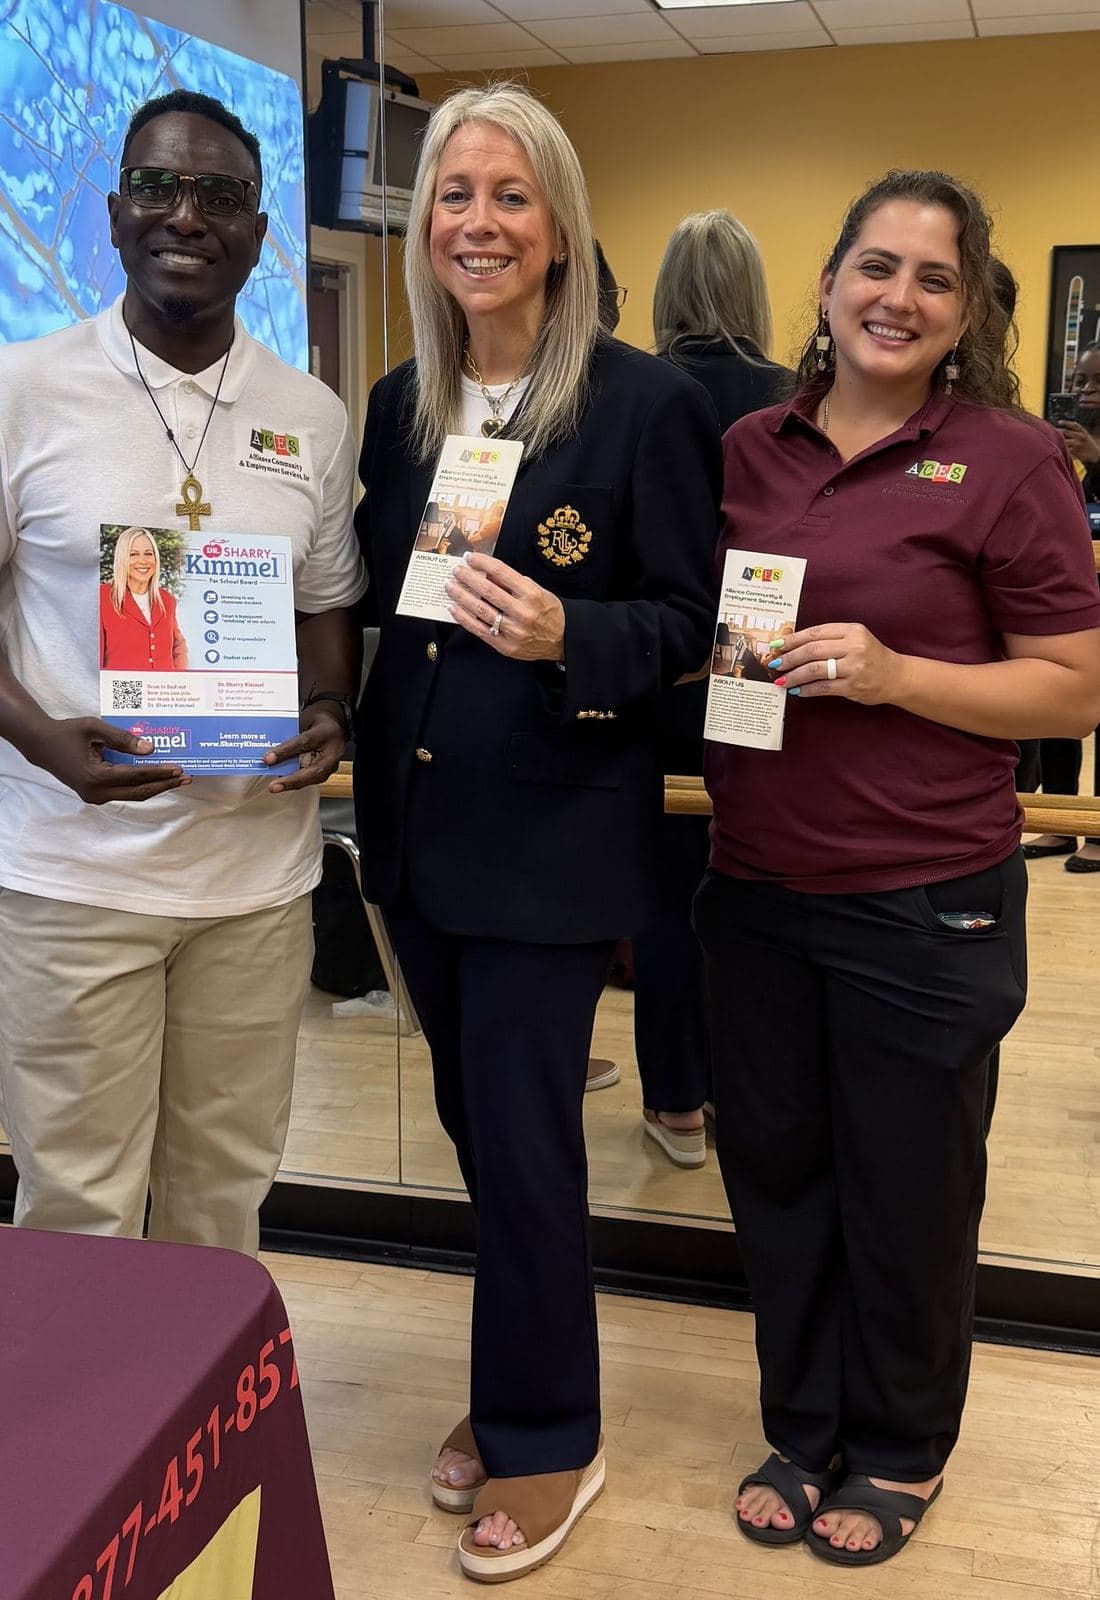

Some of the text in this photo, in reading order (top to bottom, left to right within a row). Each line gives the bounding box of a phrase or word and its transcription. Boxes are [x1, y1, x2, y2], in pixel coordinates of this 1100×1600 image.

[250, 429, 299, 456] ACES
[460, 450, 500, 463] ACES
[246, 460, 280, 473] Employment
[272, 458, 302, 472] Community
[905, 461, 965, 482] ACES
[224, 548, 271, 558] SHARRY
[416, 554, 438, 562] ABOUT
[186, 554, 279, 577] Kimmel
[742, 566, 782, 582] ACES
[746, 591, 778, 599] Community
[713, 678, 735, 686] ABOUT
[141, 732, 186, 747] mmel
